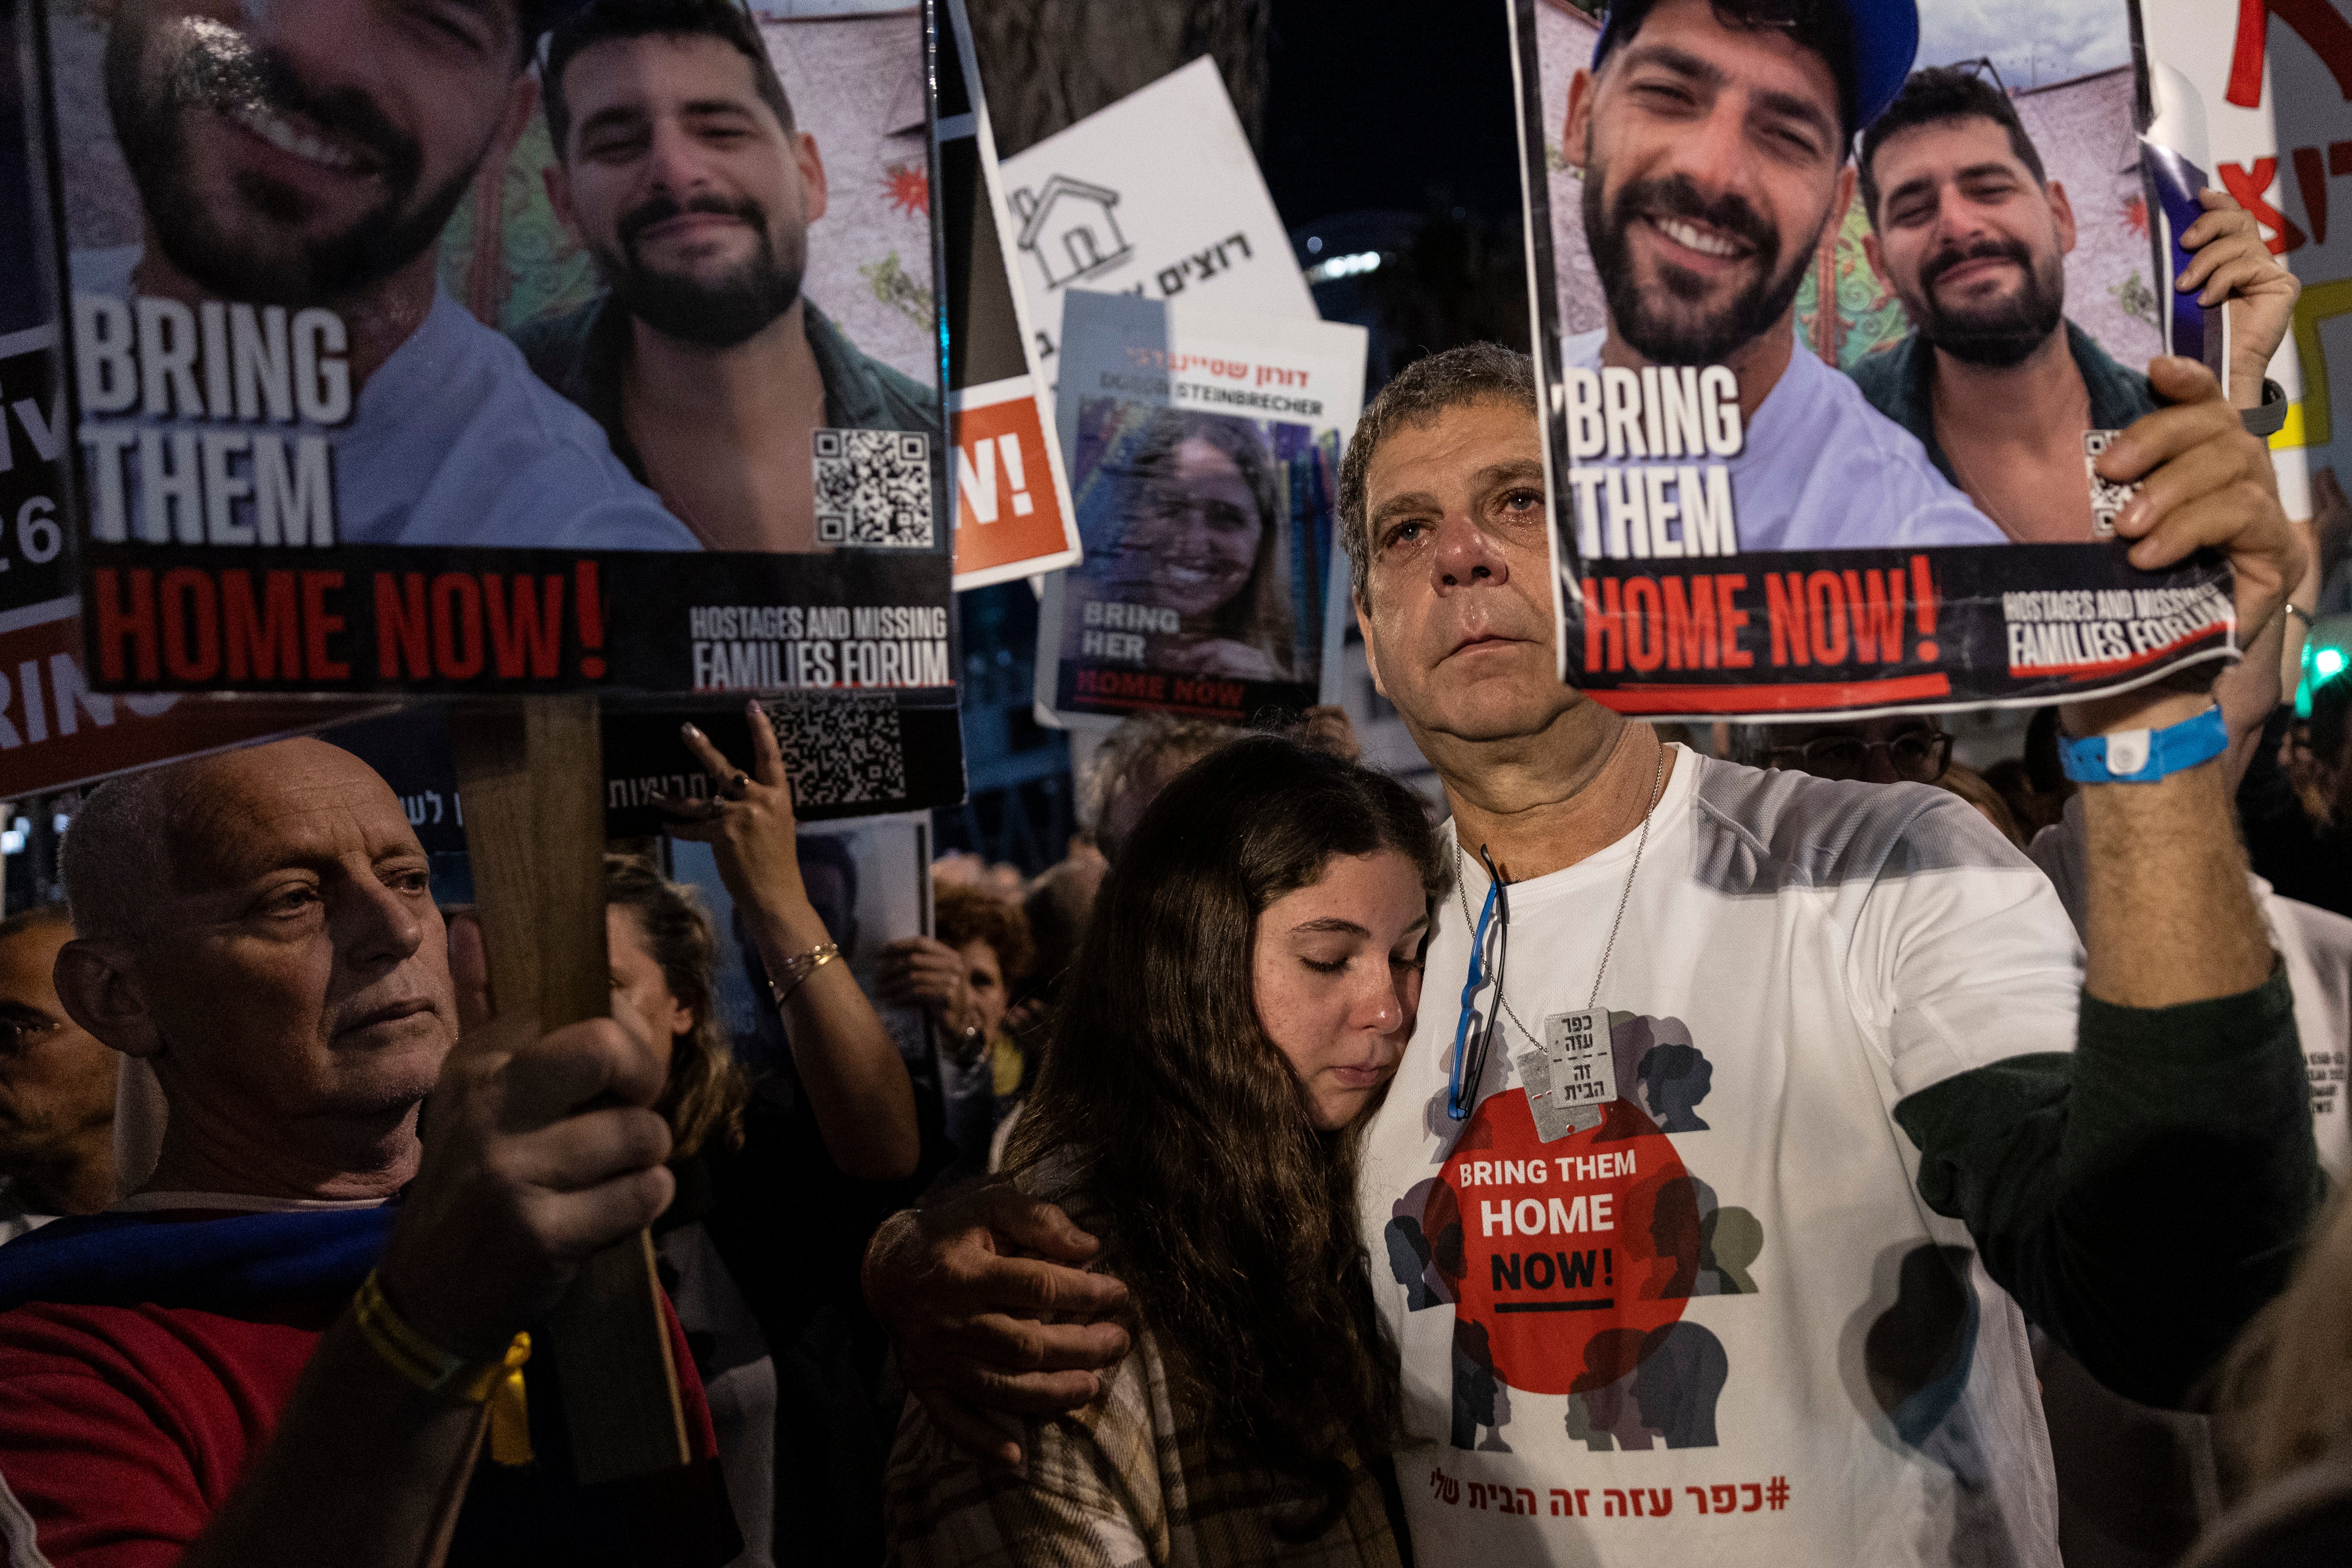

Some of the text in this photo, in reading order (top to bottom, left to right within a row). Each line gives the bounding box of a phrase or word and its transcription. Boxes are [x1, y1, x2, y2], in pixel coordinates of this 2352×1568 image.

[1158, 232, 1253, 297] רוצים
[77, 297, 352, 426] BRING
[1256, 364, 1311, 388] דורון
[1175, 383, 1324, 416] STEINBRECHER
[1564, 364, 1743, 457] BRING
[78, 421, 336, 548] THEM
[1568, 465, 1738, 558] THEM
[95, 560, 608, 683] HOME NOW!
[689, 605, 947, 640] HOSTAGES AND MISSING
[1083, 600, 1181, 635] BRING
[1581, 554, 1941, 674] HOME NOW!
[2096, 588, 2135, 621] AND
[1082, 629, 1147, 662] HER
[2007, 593, 2237, 668] FAMILIES FORUM
[693, 640, 949, 689] FAMILIES FORUM
[1077, 669, 1245, 709] HOME NOW
[1561, 1015, 1592, 1033] כפר
[1565, 1032, 1593, 1051] עזה
[1564, 1081, 1605, 1101] הבית
[1573, 1064, 1591, 1081] זה
[1460, 1149, 1636, 1188] BRING THEM
[1480, 1193, 1614, 1237] HOME
[1491, 1248, 1613, 1292] NOW!
[1430, 1466, 1791, 1517] #כפר עזה זה הבית שלי
